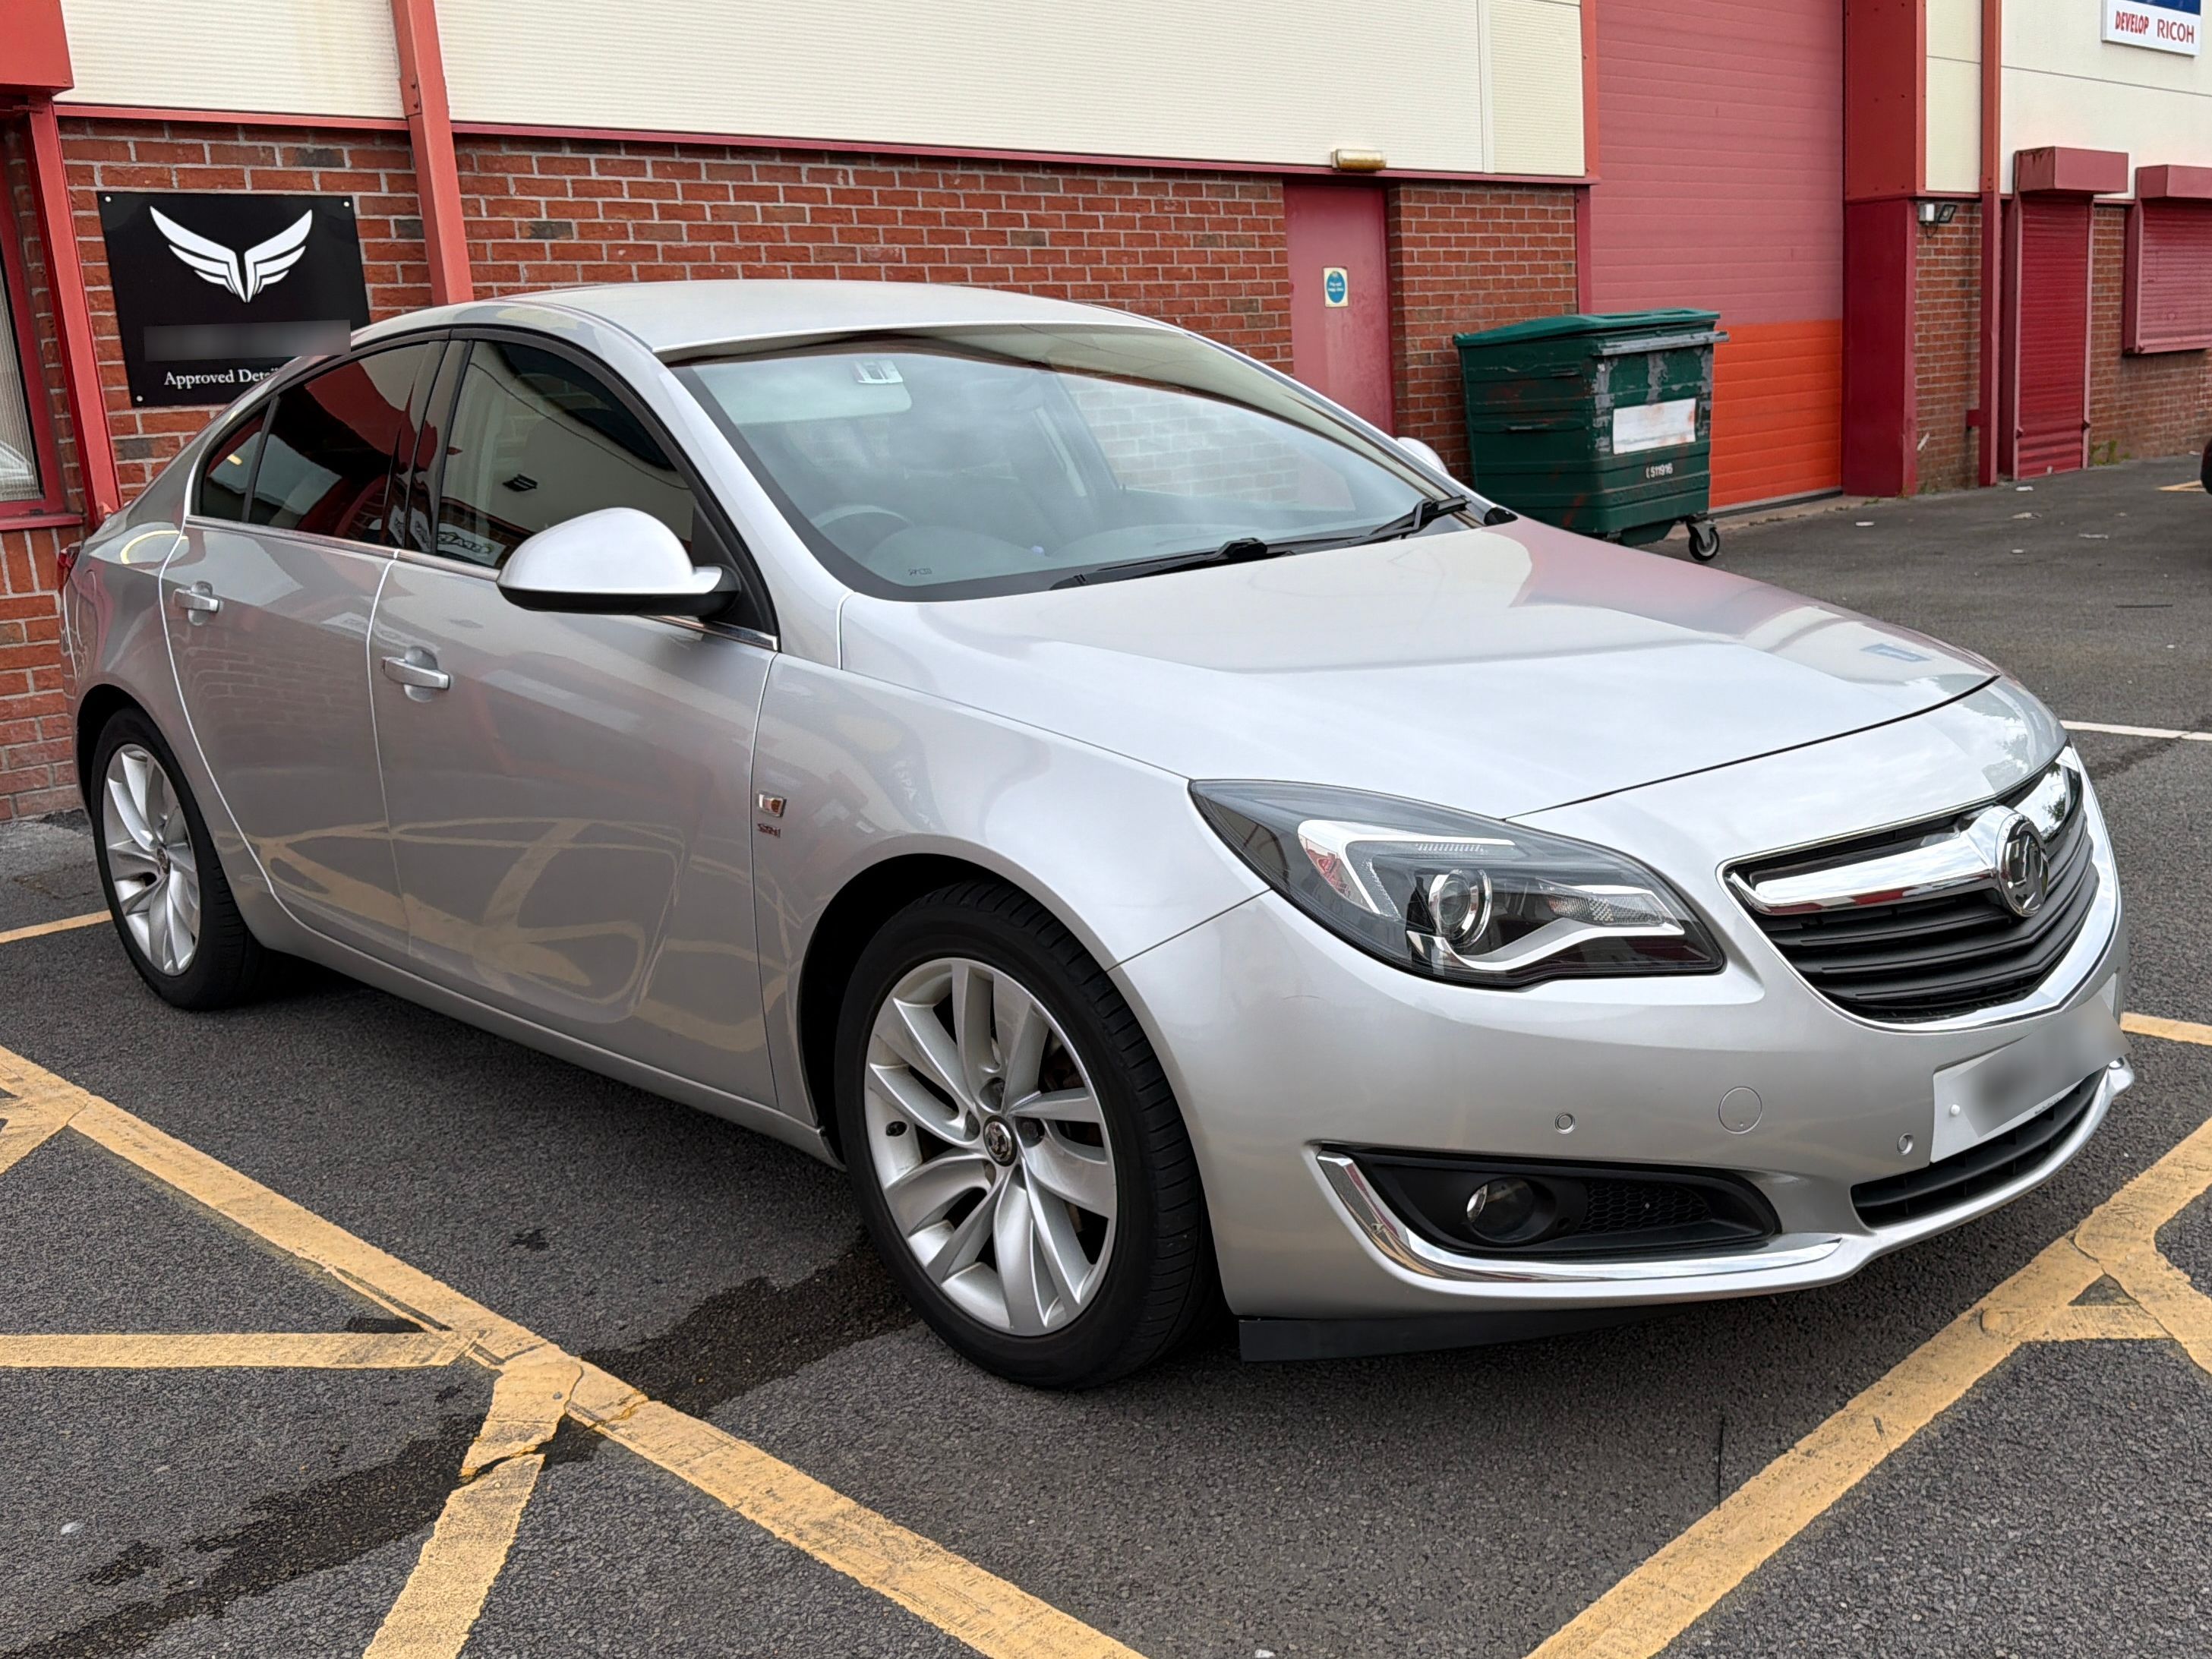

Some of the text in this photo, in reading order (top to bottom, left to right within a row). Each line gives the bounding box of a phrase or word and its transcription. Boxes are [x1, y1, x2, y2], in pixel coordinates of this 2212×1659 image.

[2115, 11, 2195, 43] DEVELOP RICOH
[164, 369, 235, 390] Approved
